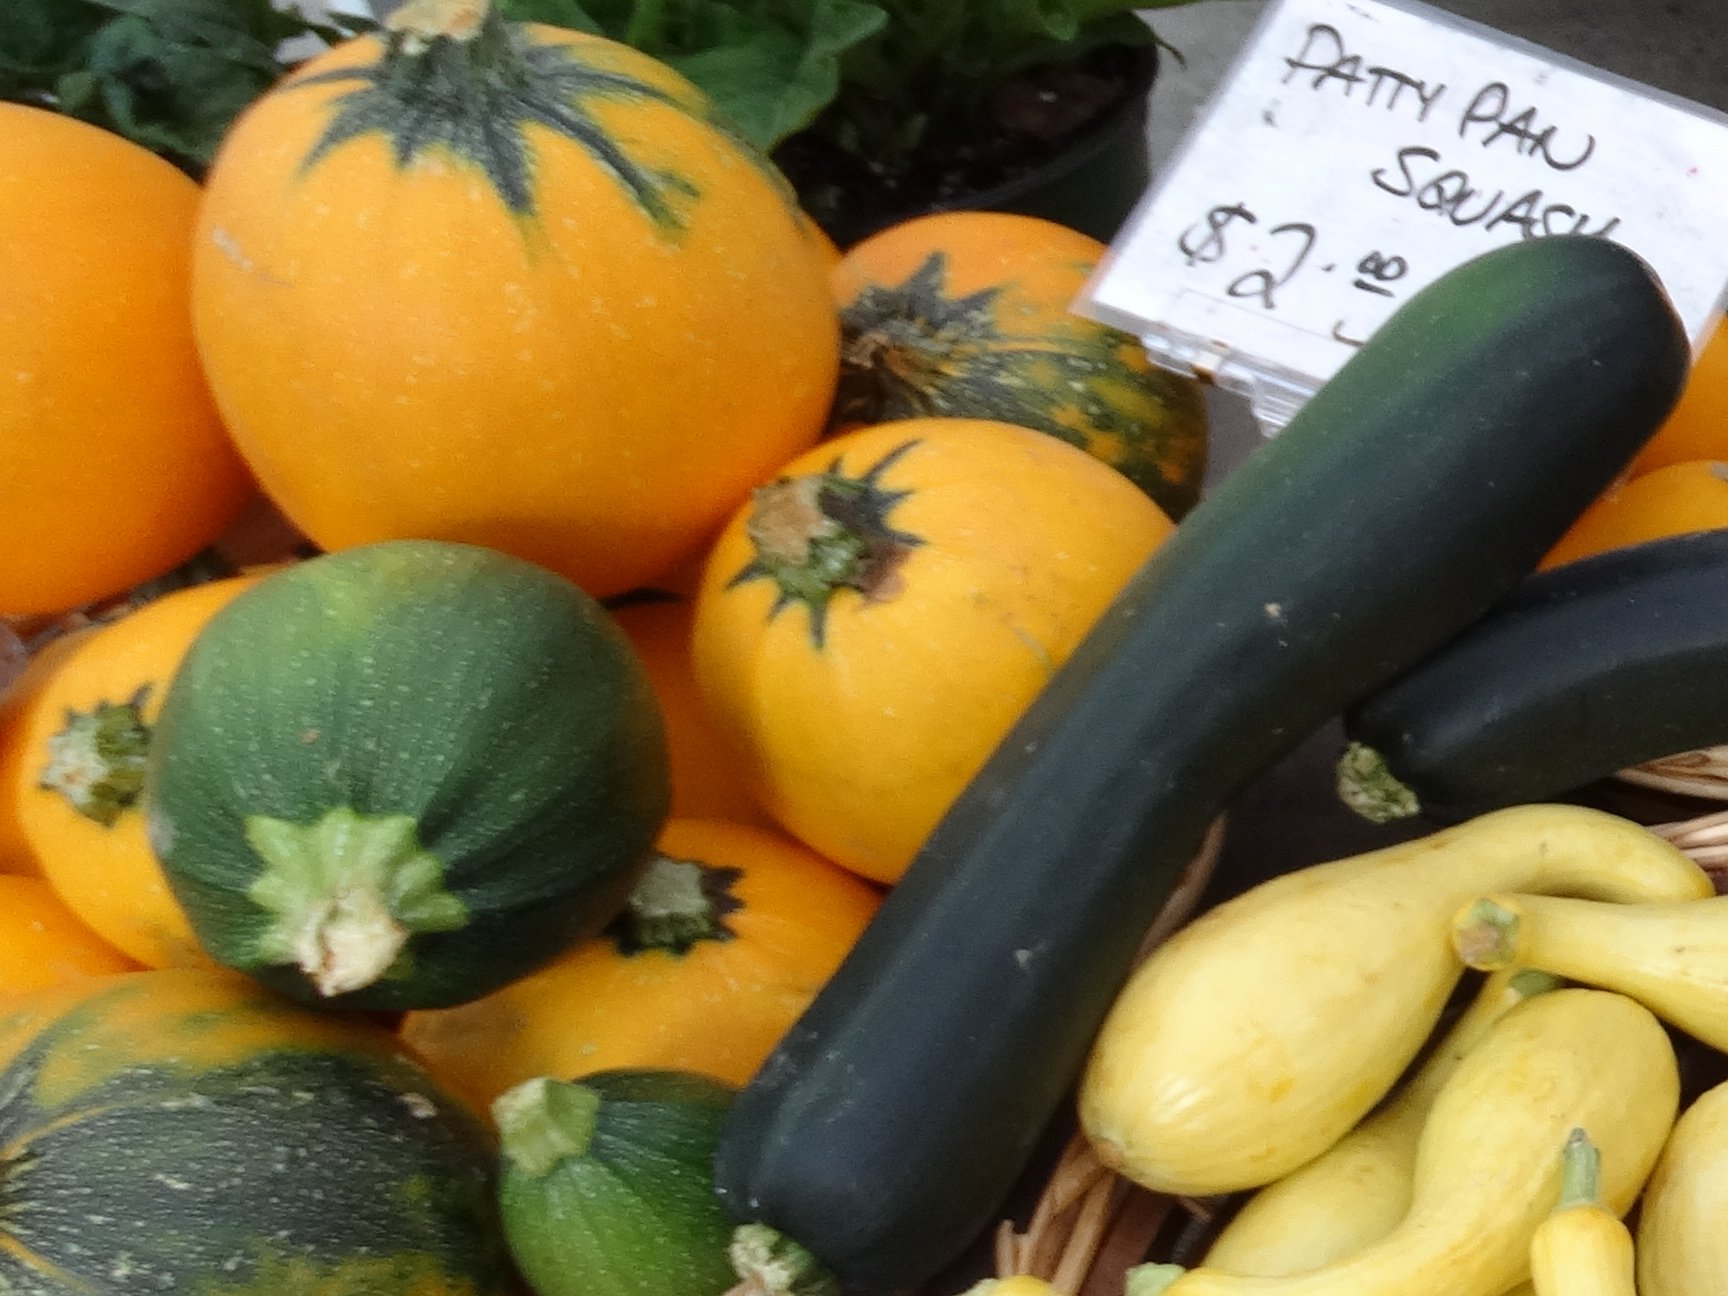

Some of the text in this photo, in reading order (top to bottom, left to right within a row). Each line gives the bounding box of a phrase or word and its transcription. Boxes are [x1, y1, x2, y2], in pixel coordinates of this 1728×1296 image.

[1281, 24, 1596, 171] PATTY PAN
[1178, 202, 1409, 310] $2.00
